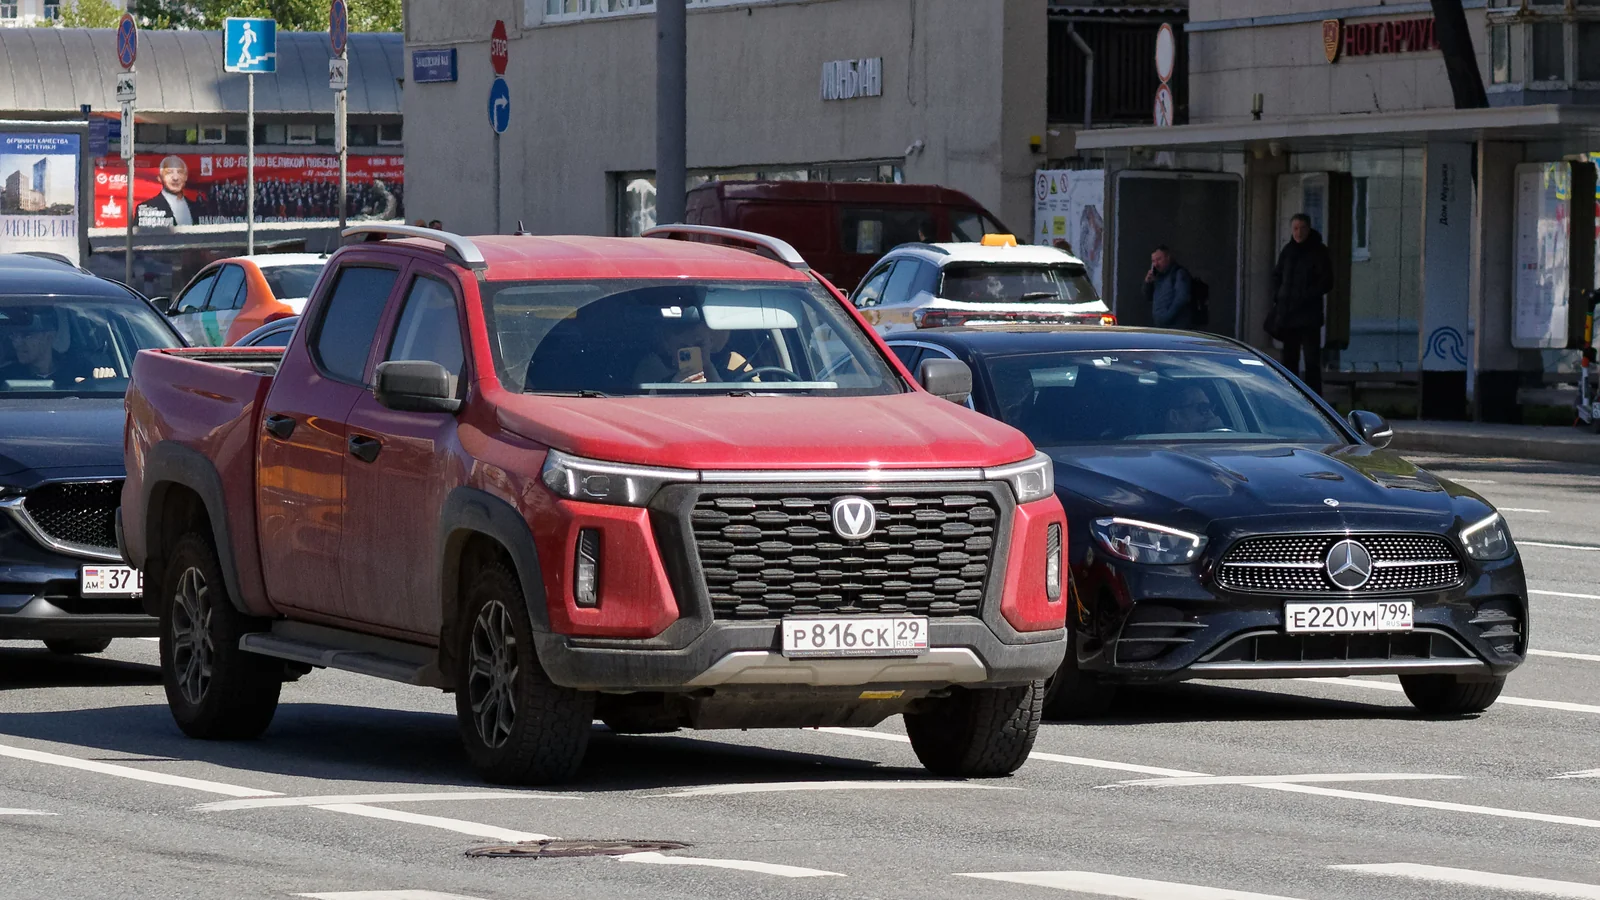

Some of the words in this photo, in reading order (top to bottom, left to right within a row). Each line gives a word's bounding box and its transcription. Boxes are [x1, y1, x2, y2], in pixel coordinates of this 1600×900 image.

[492, 38, 507, 57] STOP
[1345, 18, 1440, 56] НОТАРИУС
[821, 57, 882, 100] МОНБЛАН
[1439, 203, 1448, 226] Дом
[85, 581, 99, 589] AM
[109, 569, 131, 589] 37
[1294, 606, 1376, 628] Е220УМ
[1379, 603, 1407, 620] 799
[794, 623, 890, 648] Р816СК
[896, 621, 920, 640] 29
[896, 639, 914, 647] RUS
